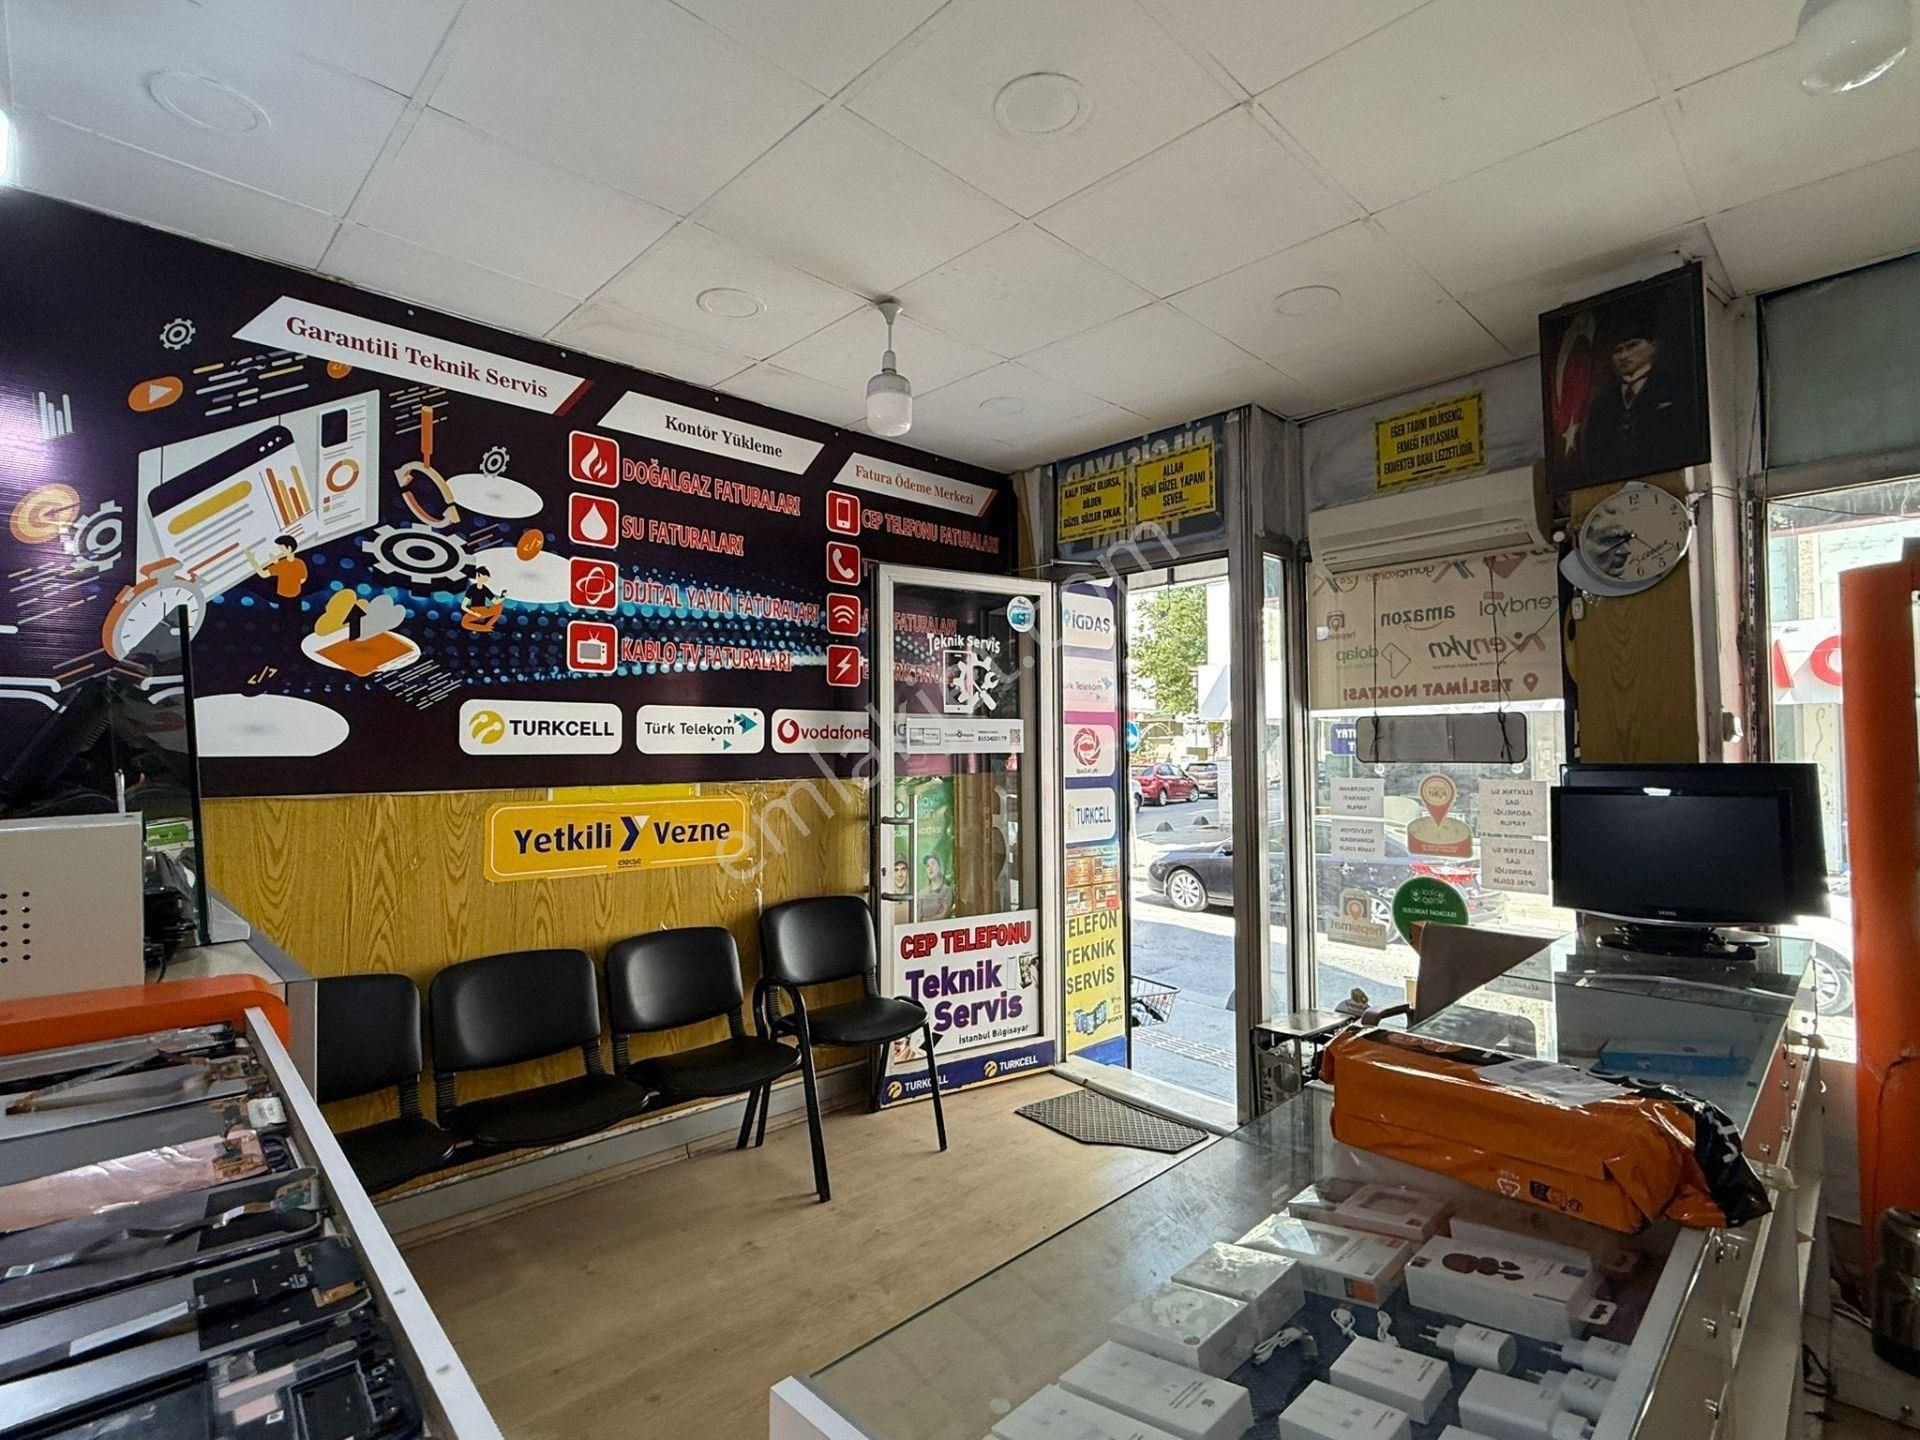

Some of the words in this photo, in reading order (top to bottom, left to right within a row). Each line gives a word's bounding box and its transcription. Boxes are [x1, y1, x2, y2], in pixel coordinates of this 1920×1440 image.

[286, 315, 399, 361] Garantili
[405, 346, 481, 382] Teknik
[485, 367, 548, 398] Servis
[664, 414, 719, 443] Kontör
[721, 428, 783, 458] Yükleme
[1162, 461, 1184, 477] ALLAH
[1180, 471, 1206, 487] YAPANI
[623, 456, 712, 498] DOĞALGAZ
[714, 479, 801, 516] FATURALARI
[855, 464, 893, 487] Fatura
[894, 472, 933, 495] Ödeme
[934, 484, 974, 505] Merkezi
[621, 516, 646, 539] SU
[648, 520, 744, 556] FATURALARI
[861, 509, 883, 528] CEP
[884, 513, 938, 541] TELEFONU
[939, 525, 999, 554] FATURALARI
[622, 577, 683, 607] DİJİTAL
[686, 586, 732, 612] YAYIN
[737, 595, 819, 622] FATURALARI
[1072, 610, 1111, 634] İGDAŞ
[621, 638, 677, 665] KABLO
[679, 643, 702, 667] TV
[704, 646, 792, 672] FATURALARI
[926, 632, 965, 656] Teknik
[966, 634, 1000, 654] Servis
[509, 719, 615, 738] TURKCELL
[644, 720, 675, 736] Türk
[679, 722, 736, 738] Telekom
[800, 722, 870, 740] vodafone
[1076, 807, 1111, 825] TURKCELL
[513, 822, 612, 855] Yetkili
[653, 818, 731, 846] Vezne
[1066, 910, 1117, 938] ELEFON
[900, 932, 937, 959] CEP
[941, 920, 1032, 954] TELEFONU
[1066, 937, 1116, 967] TEKNİK
[905, 959, 1002, 999] Teknik
[1066, 964, 1115, 995] SERVİS
[933, 990, 1023, 1033] Servis
[959, 1031, 991, 1044] İstanbul
[991, 1023, 1030, 1040] Bilgisayar
[999, 1055, 1039, 1071] TURKCELL
[904, 1074, 949, 1093] TURKCLL
